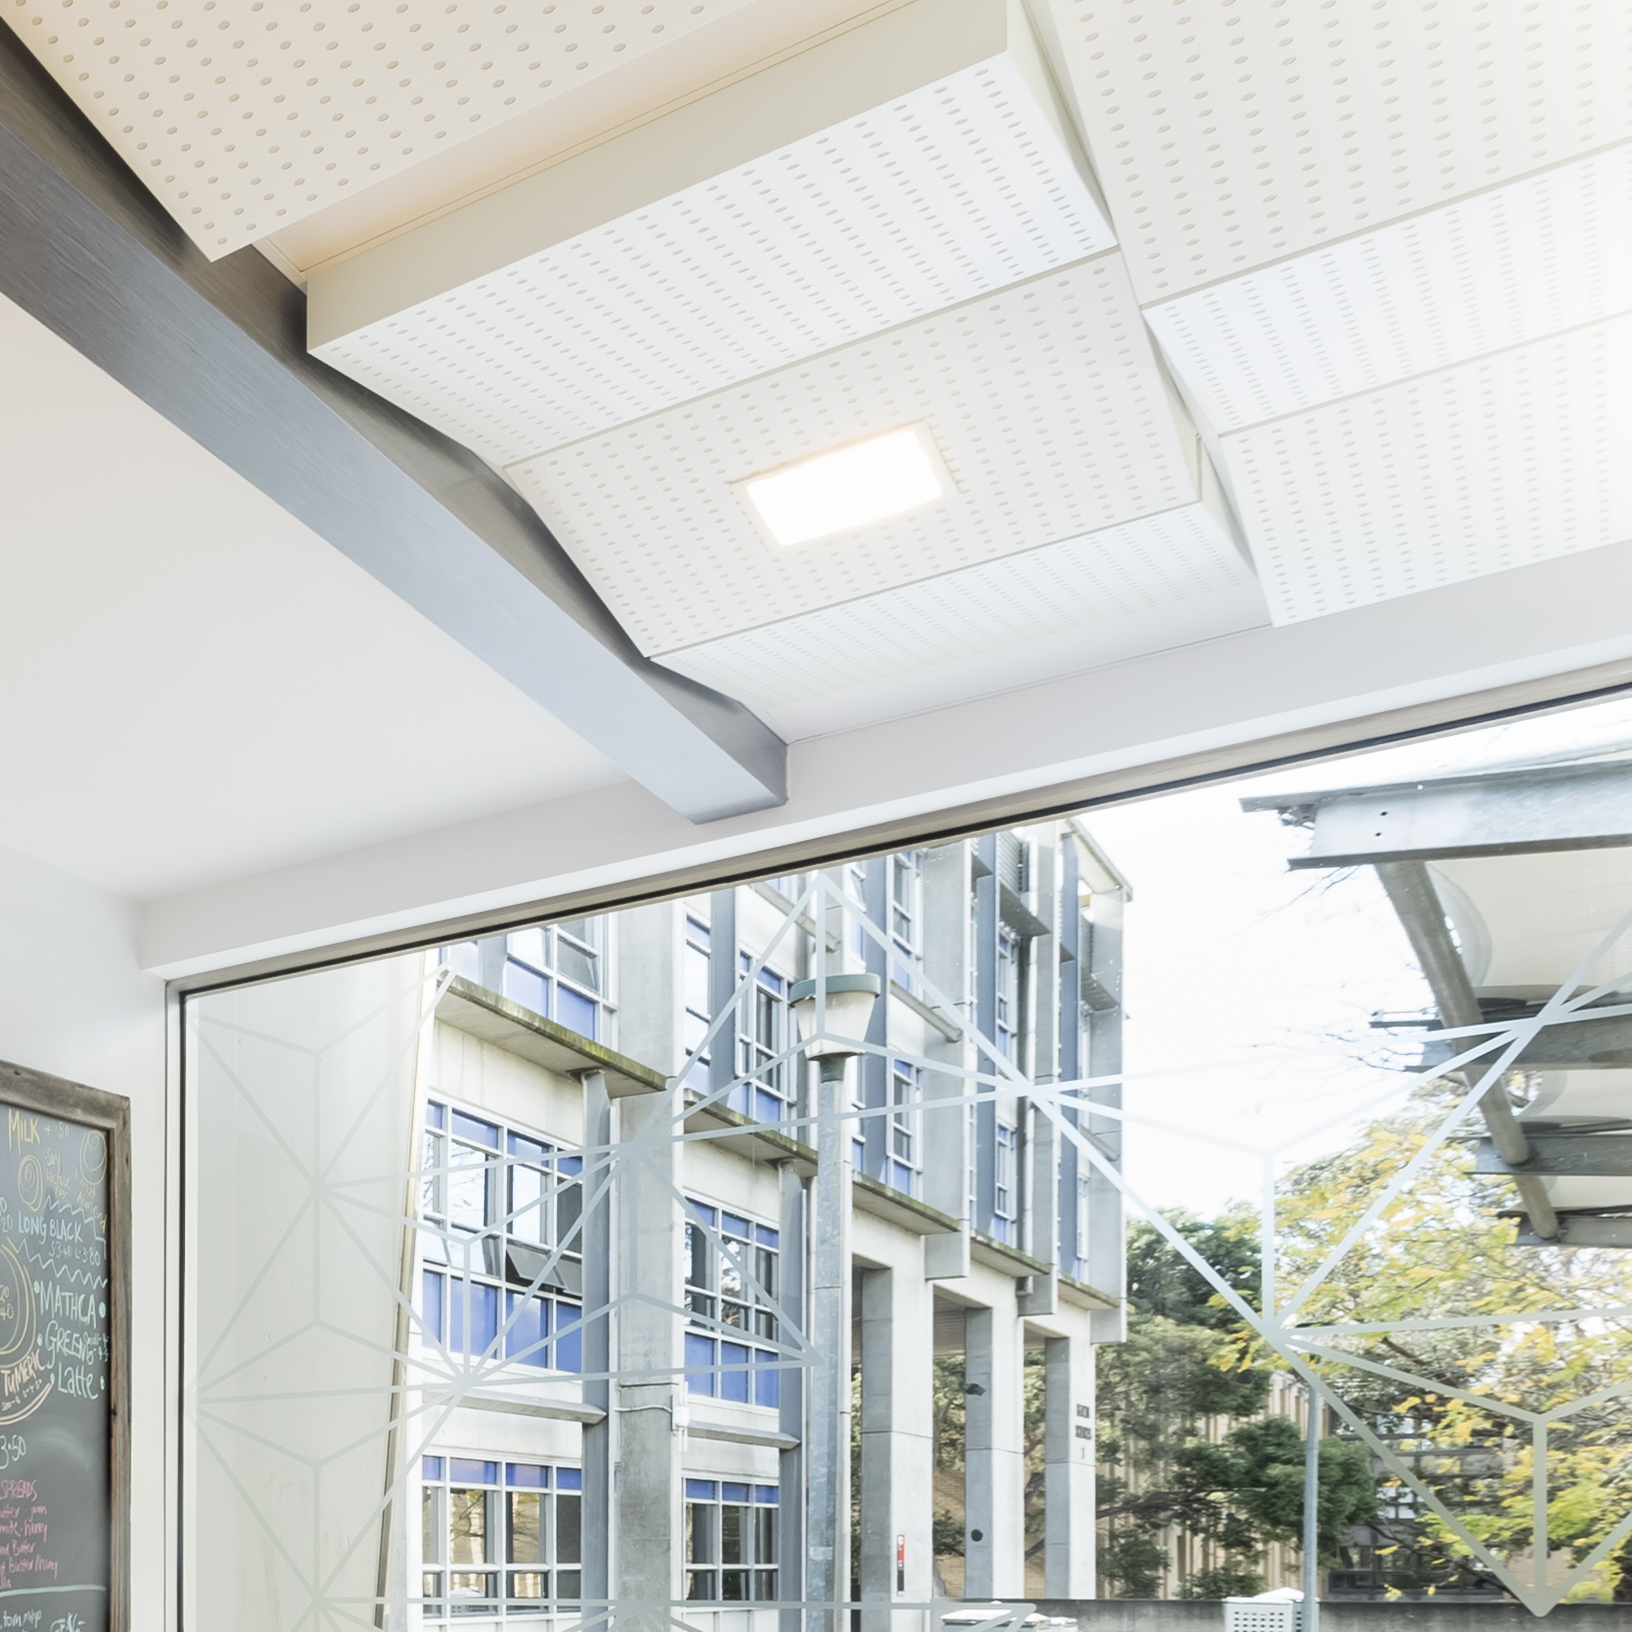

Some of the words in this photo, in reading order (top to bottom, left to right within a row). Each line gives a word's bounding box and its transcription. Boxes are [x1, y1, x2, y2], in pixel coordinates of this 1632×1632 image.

[8, 1108, 41, 1156] MILK
[18, 1210, 47, 1245] LONG
[49, 1218, 83, 1244] BLACK
